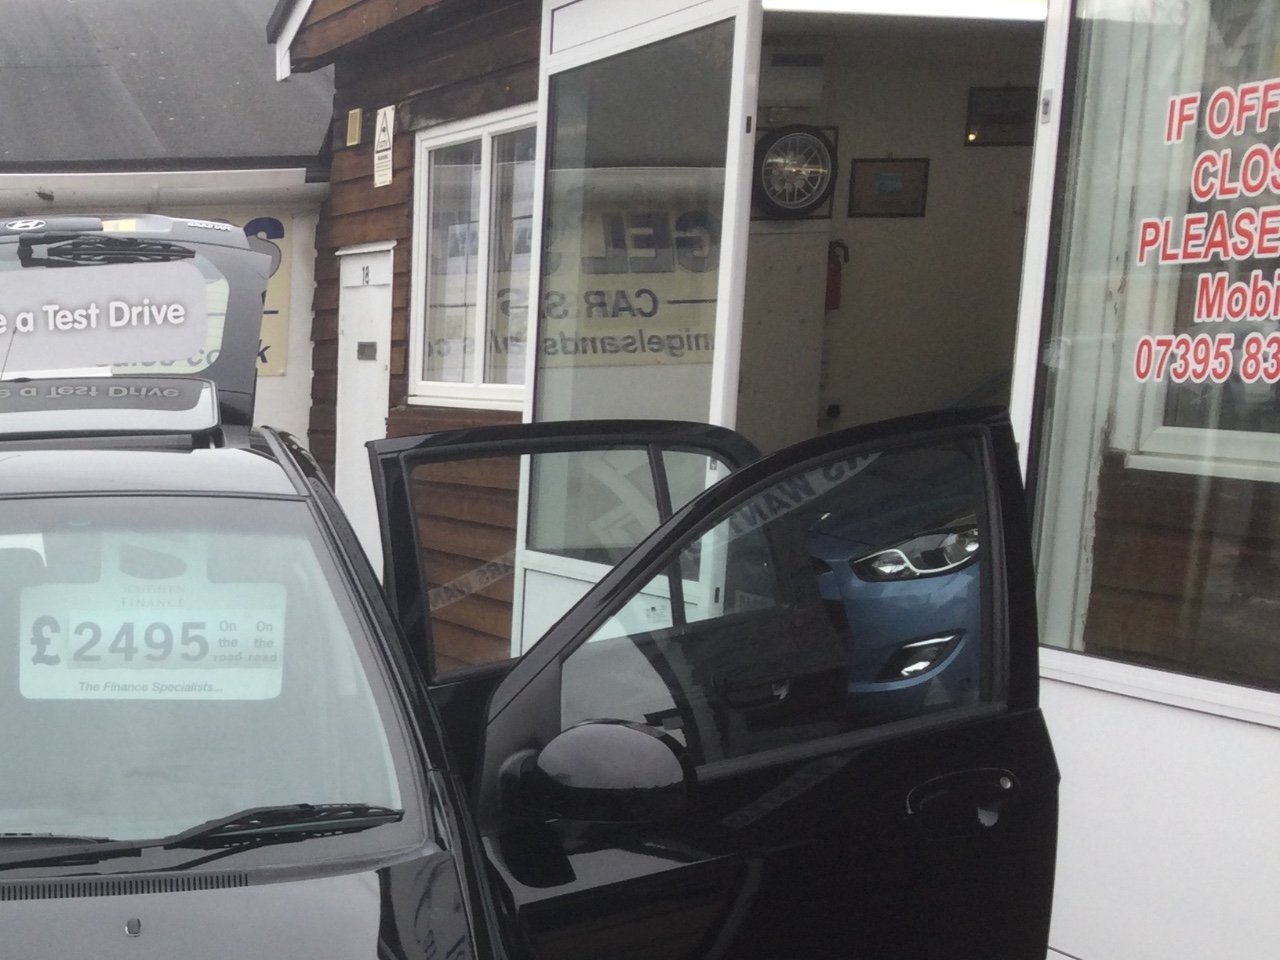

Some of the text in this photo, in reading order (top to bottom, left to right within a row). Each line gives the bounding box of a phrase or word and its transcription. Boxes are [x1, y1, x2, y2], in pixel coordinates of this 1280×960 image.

[1165, 92, 1200, 144] IF
[1137, 206, 1280, 265] PLEASE
[15, 311, 34, 332] a
[42, 303, 100, 331] Test
[109, 298, 186, 328] Drive
[1134, 333, 1234, 384] 07395
[219, 620, 237, 632] On
[256, 620, 273, 632] On
[31, 615, 209, 666] £2495
[218, 636, 238, 648] the
[254, 637, 274, 648] the
[79, 682, 100, 691] The
[103, 682, 148, 692] Finance
